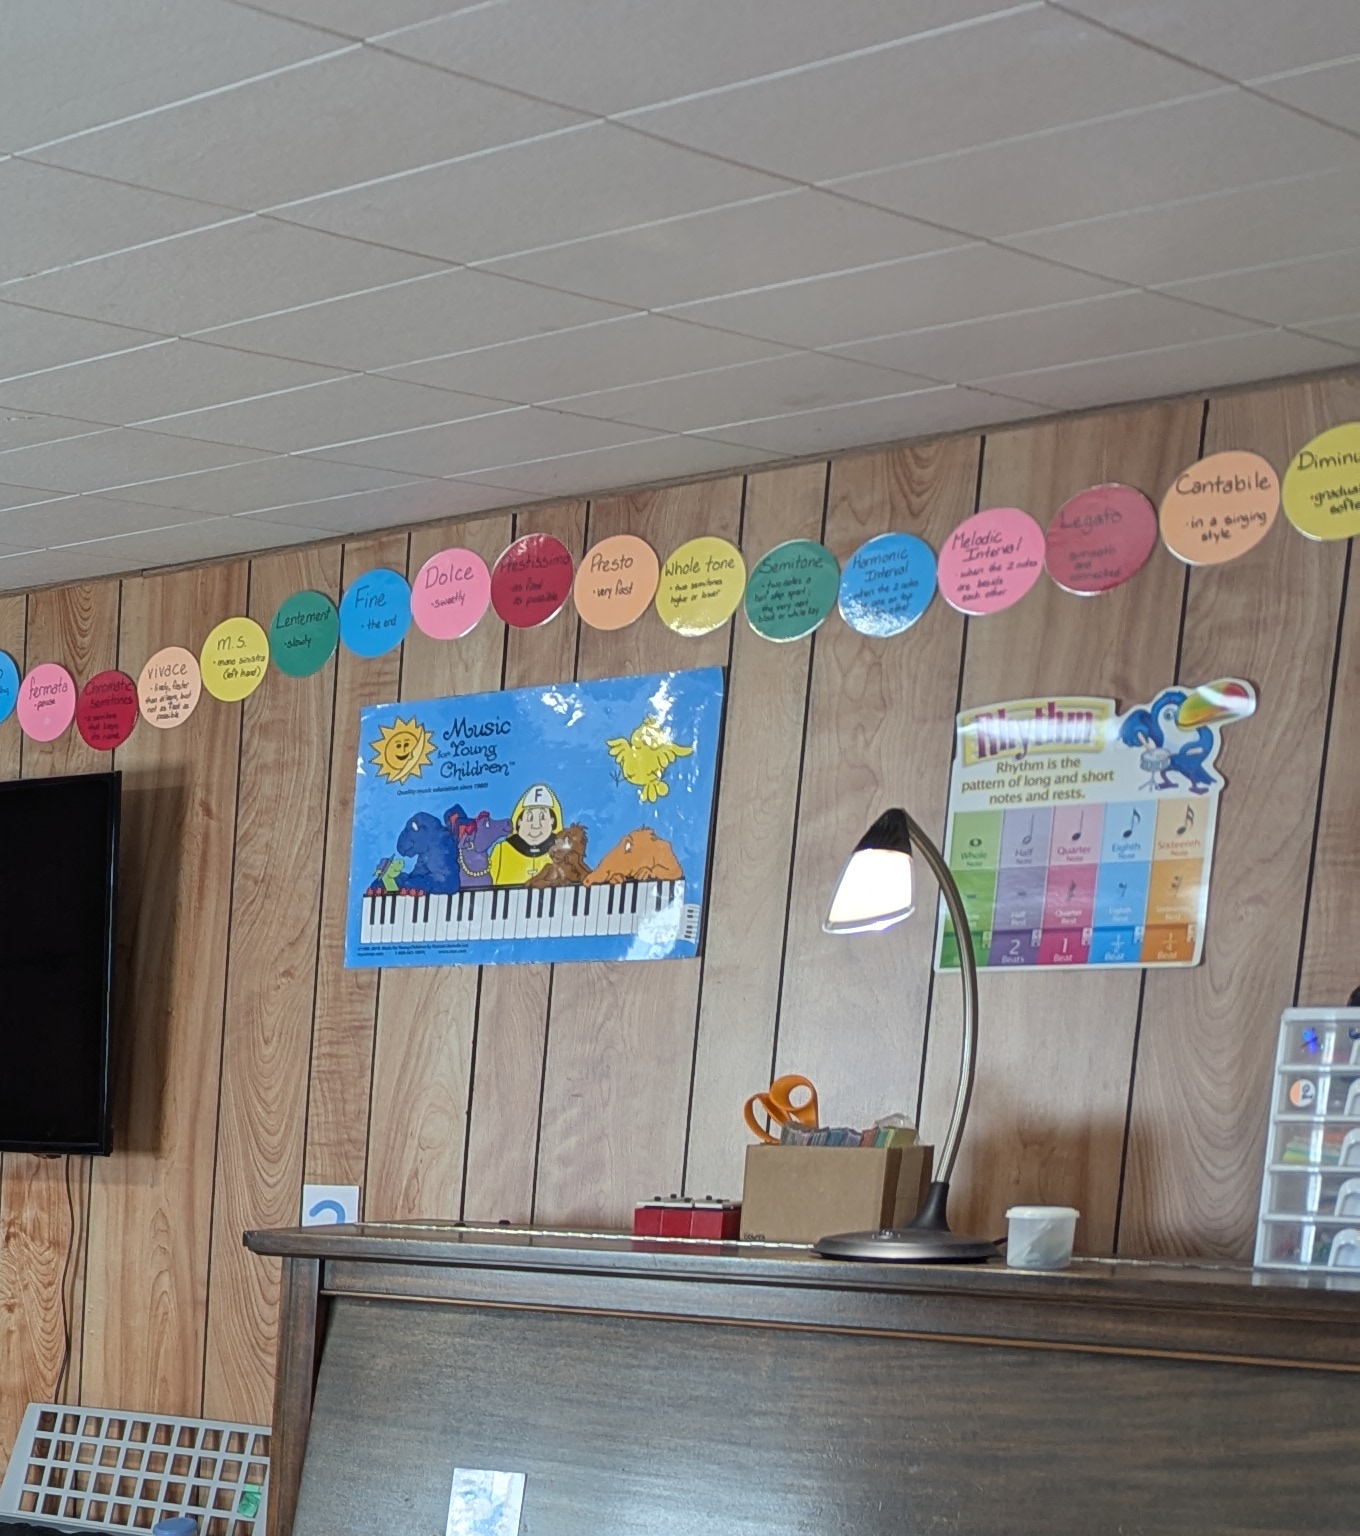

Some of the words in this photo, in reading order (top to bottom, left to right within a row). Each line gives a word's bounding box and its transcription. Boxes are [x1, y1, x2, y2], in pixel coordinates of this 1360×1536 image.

[1175, 471, 1272, 496] Cantabile
[1060, 507, 1122, 535] Legato
[1190, 515, 1204, 529] in
[1210, 517, 1218, 527] a
[1225, 510, 1267, 530] singing
[952, 530, 1003, 551] Melodic
[1201, 528, 1231, 543] style
[852, 548, 909, 571] Harmonic
[962, 536, 1023, 563] Interval
[590, 552, 634, 574] Presto
[665, 556, 701, 577] Whole
[706, 555, 735, 574] tone
[758, 554, 824, 575] Semitone
[864, 561, 909, 583] Interval
[424, 563, 475, 589] Dolce
[355, 585, 387, 609] Fine
[596, 587, 612, 599] very
[615, 578, 634, 594] fast
[276, 607, 331, 629] Lentement
[366, 617, 380, 629] the
[383, 615, 397, 628] end
[147, 662, 188, 680] vivace
[28, 676, 69, 700] fermata
[443, 715, 511, 741] Music
[437, 749, 450, 759] for
[450, 740, 497, 762] Young
[996, 760, 1044, 774] Rhythm
[1047, 758, 1057, 769] is
[1061, 757, 1081, 769] the
[432, 785, 460, 794] education
[961, 779, 1006, 794] pattern
[1008, 774, 1021, 787] of
[1023, 775, 1051, 789] long
[1054, 772, 1078, 785] and
[1081, 769, 1115, 782] short
[534, 788, 544, 803] F
[989, 792, 1022, 805] notes
[1025, 789, 1050, 802] and
[1052, 788, 1086, 801] rests.
[1014, 847, 1033, 858] Half
[1057, 845, 1091, 857] Quarter
[1111, 841, 1141, 854] Eighth
[1157, 839, 1201, 850] Sixteenth
[961, 850, 988, 861] Whole
[1009, 938, 1021, 955] 2
[1061, 937, 1068, 953] 1
[1001, 954, 1025, 964] Beats
[1053, 952, 1073, 963] Beat
